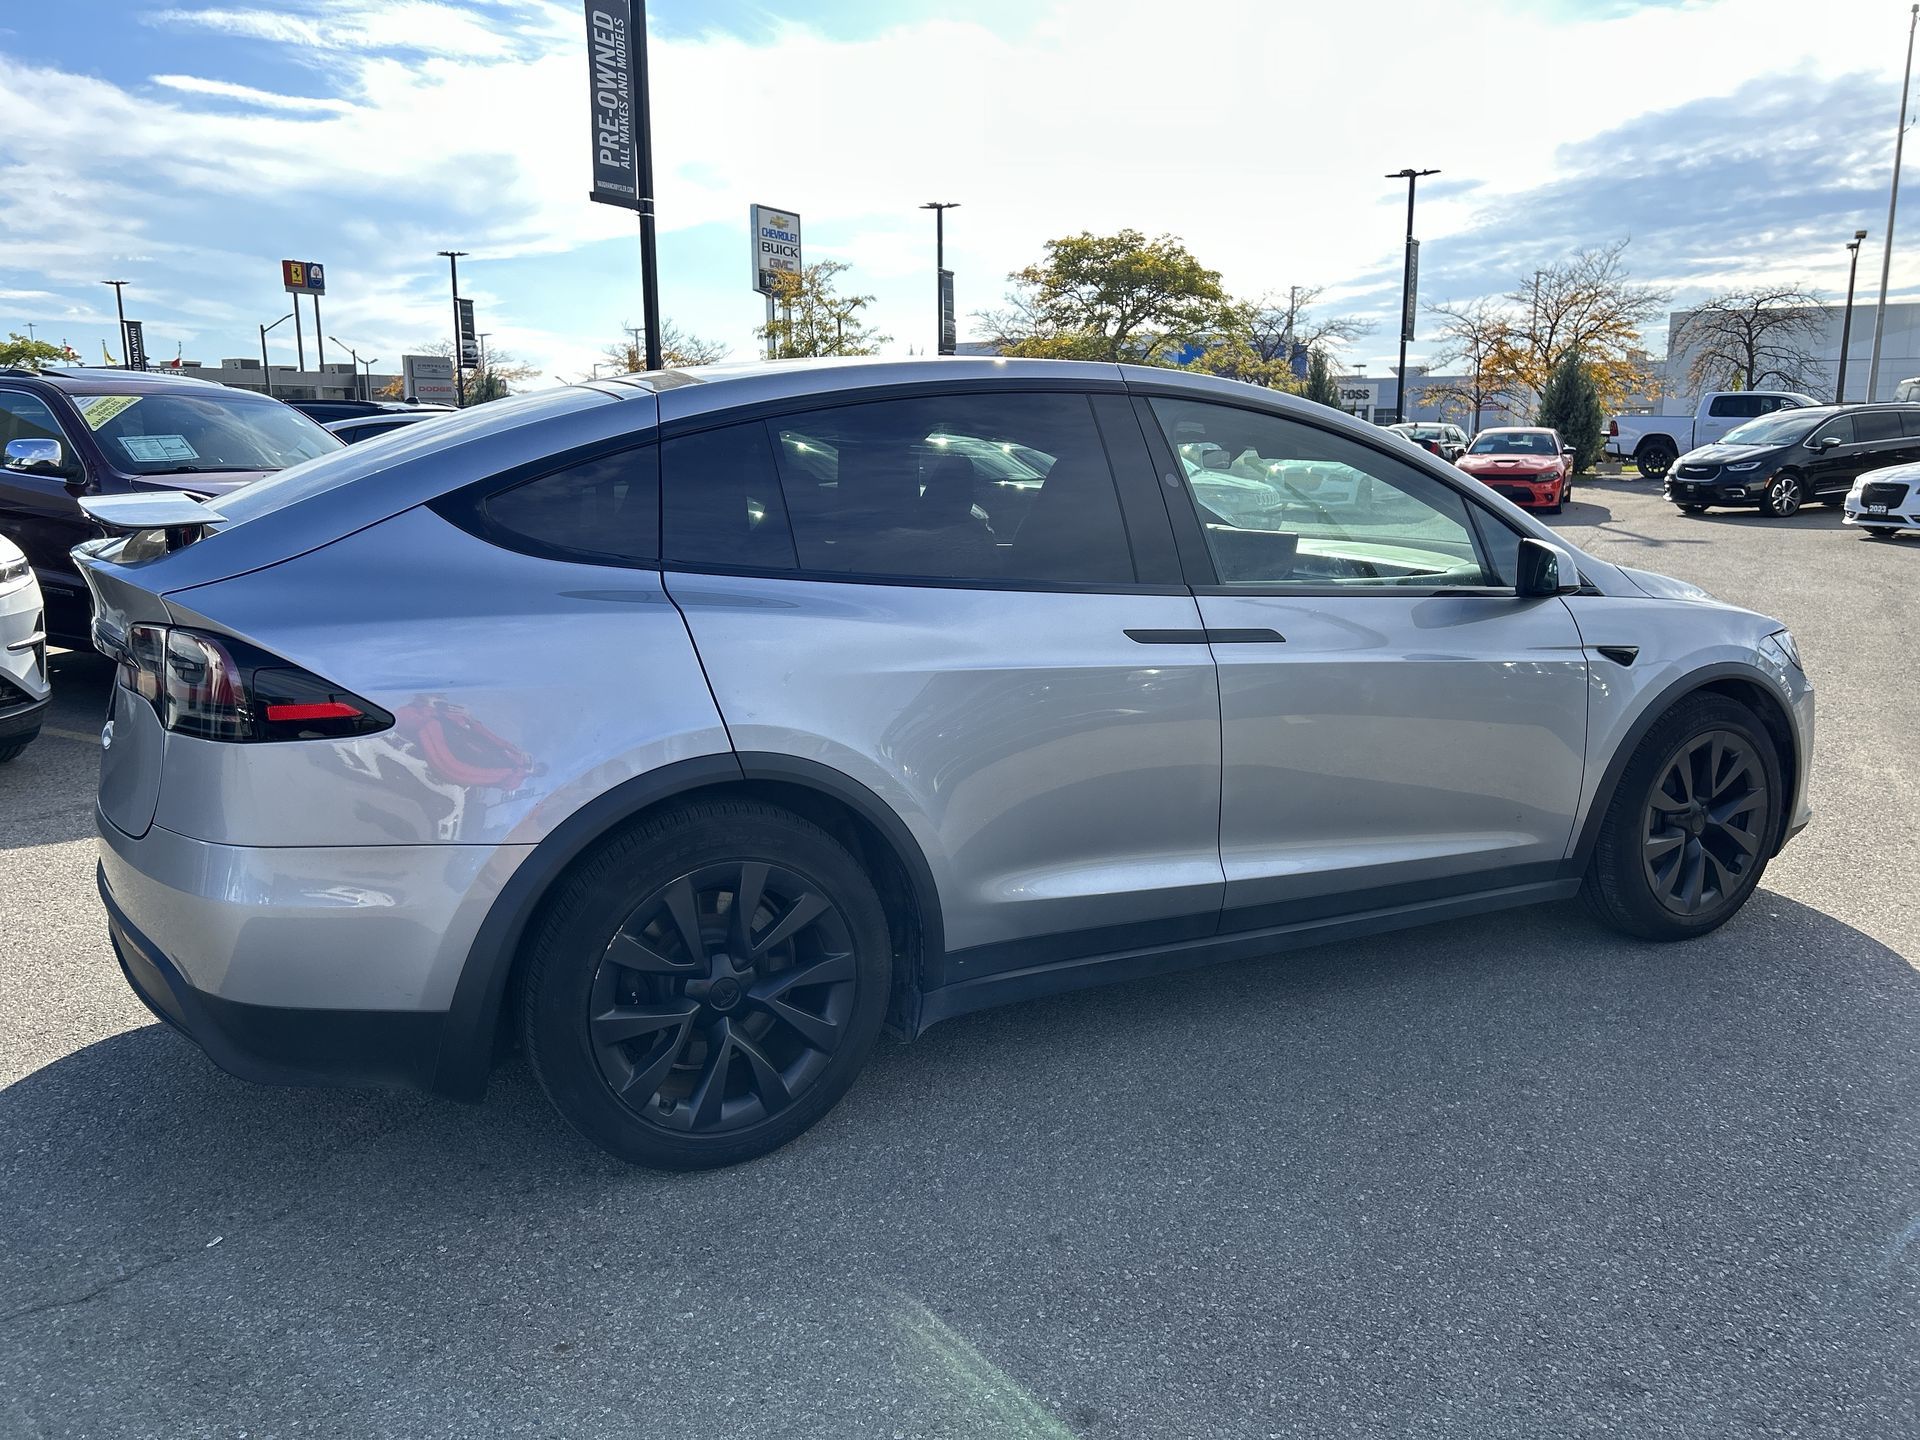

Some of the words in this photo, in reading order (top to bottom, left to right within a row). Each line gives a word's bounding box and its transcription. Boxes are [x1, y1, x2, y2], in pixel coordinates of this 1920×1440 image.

[614, 17, 627, 69] MODELS
[592, 10, 620, 167] PRE-OWNED
[617, 72, 628, 98] AND
[619, 101, 630, 144] MAKES
[620, 148, 630, 169] ALL
[761, 227, 797, 243] CHEVROLET
[761, 241, 798, 258] BUICK
[769, 257, 794, 271] GMC
[130, 328, 140, 363] DILAWRI
[1341, 389, 1370, 400] FOSS
[1869, 505, 1887, 513] 2023
